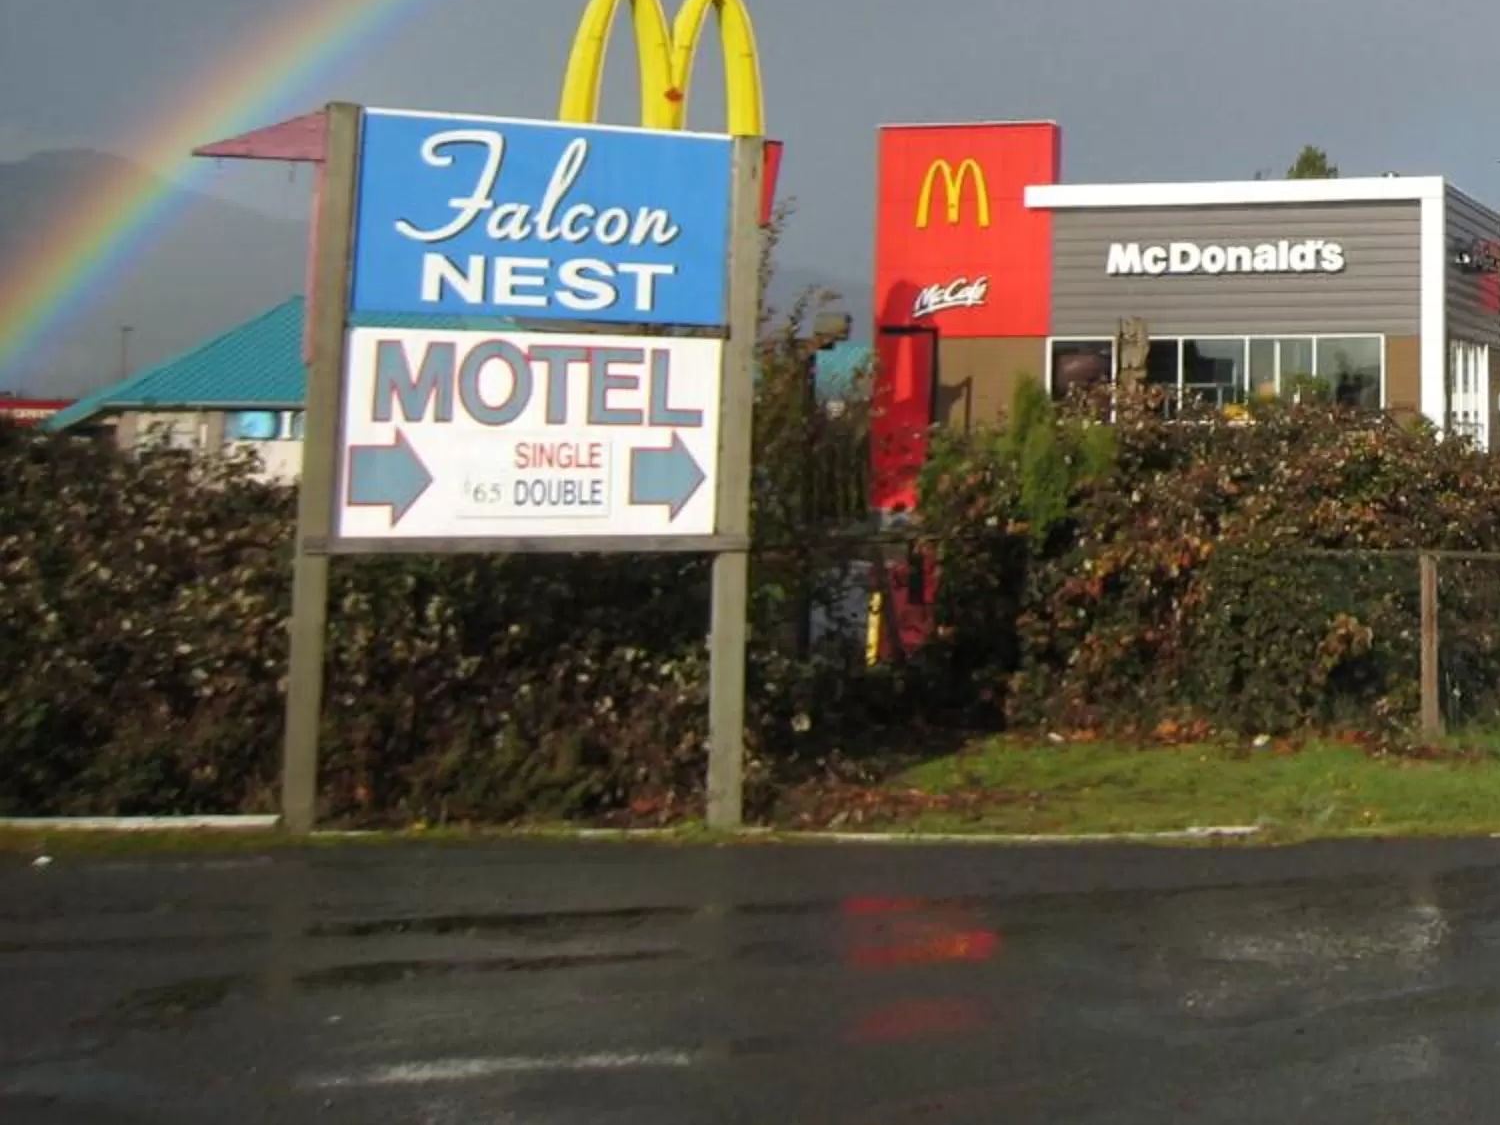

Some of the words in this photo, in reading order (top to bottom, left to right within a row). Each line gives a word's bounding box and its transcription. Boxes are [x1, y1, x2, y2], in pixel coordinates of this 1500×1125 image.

[395, 128, 679, 246] Falcon
[1106, 239, 1345, 275] McDonald's
[420, 252, 675, 312] NEST
[371, 339, 704, 428] MOTEL
[514, 441, 604, 470] SINGLE
[513, 478, 604, 507] DOUBLE
